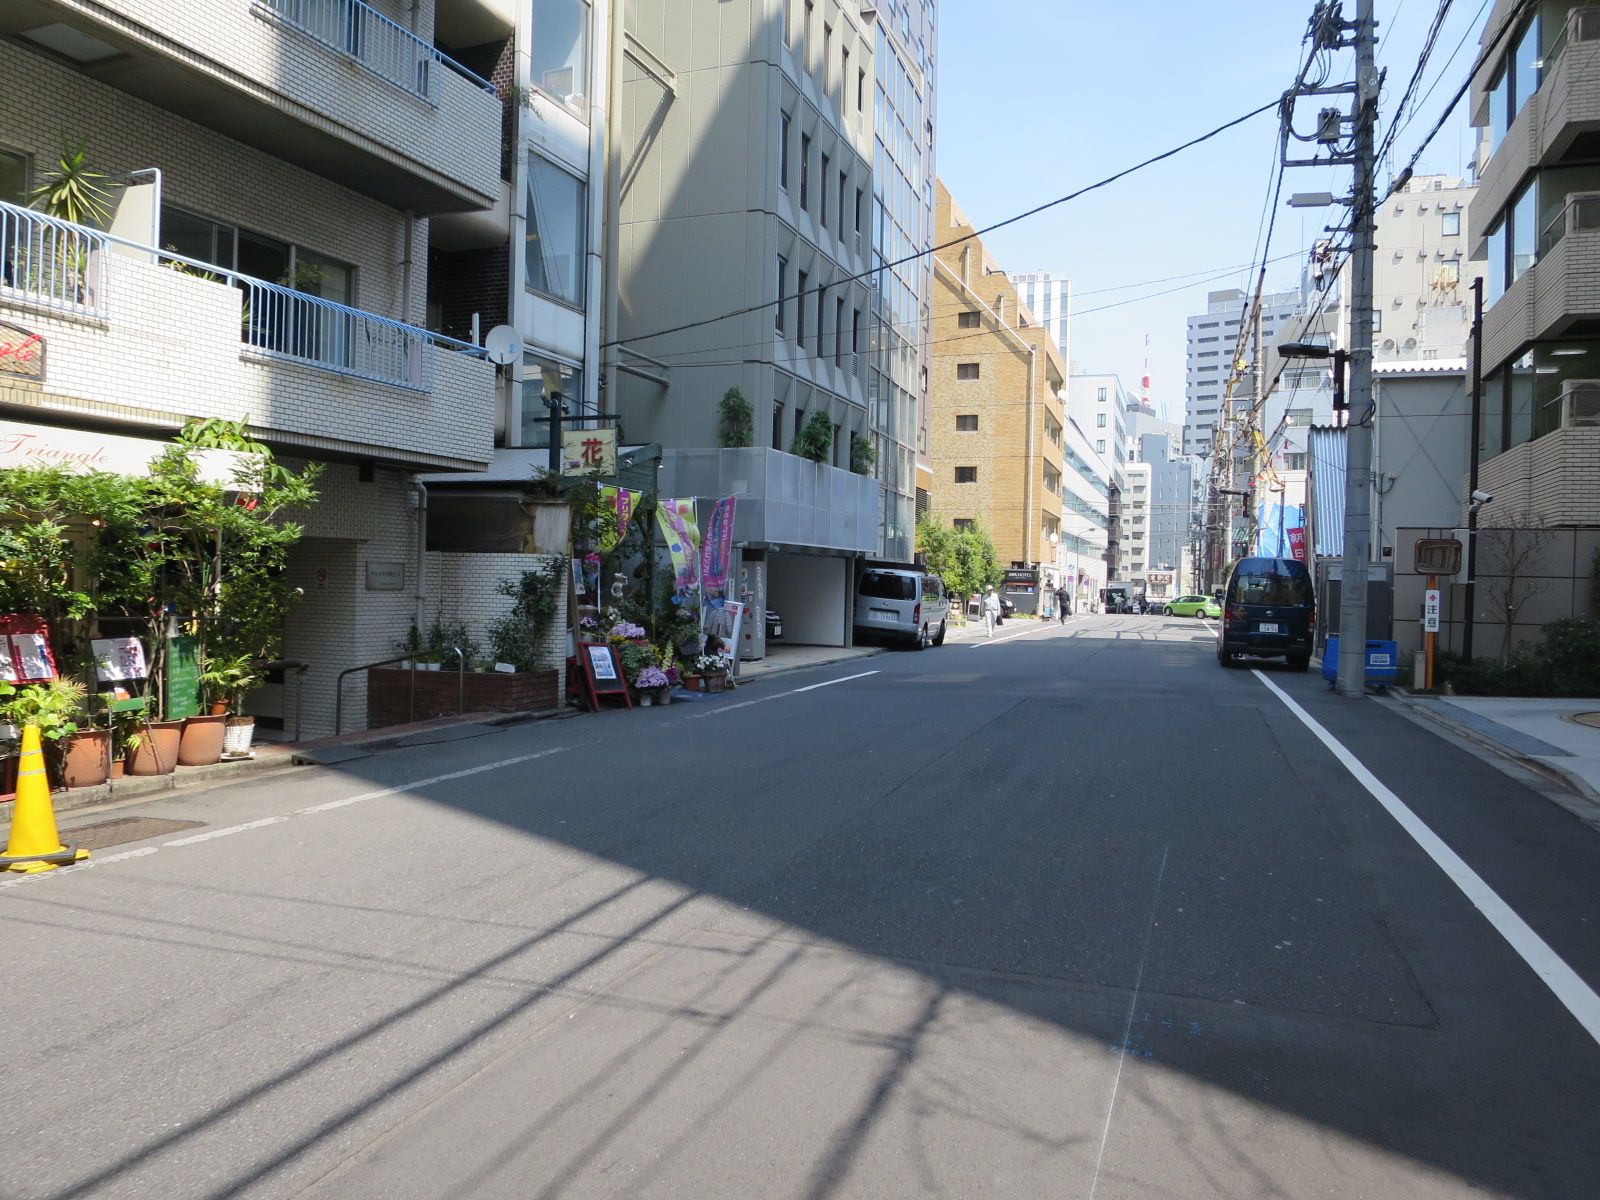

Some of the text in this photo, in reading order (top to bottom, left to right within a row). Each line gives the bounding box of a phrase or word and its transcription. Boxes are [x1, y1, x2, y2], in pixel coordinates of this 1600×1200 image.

[0, 433, 110, 468] Triangle
[580, 438, 604, 464] 花
[1427, 604, 1438, 628] 注意
